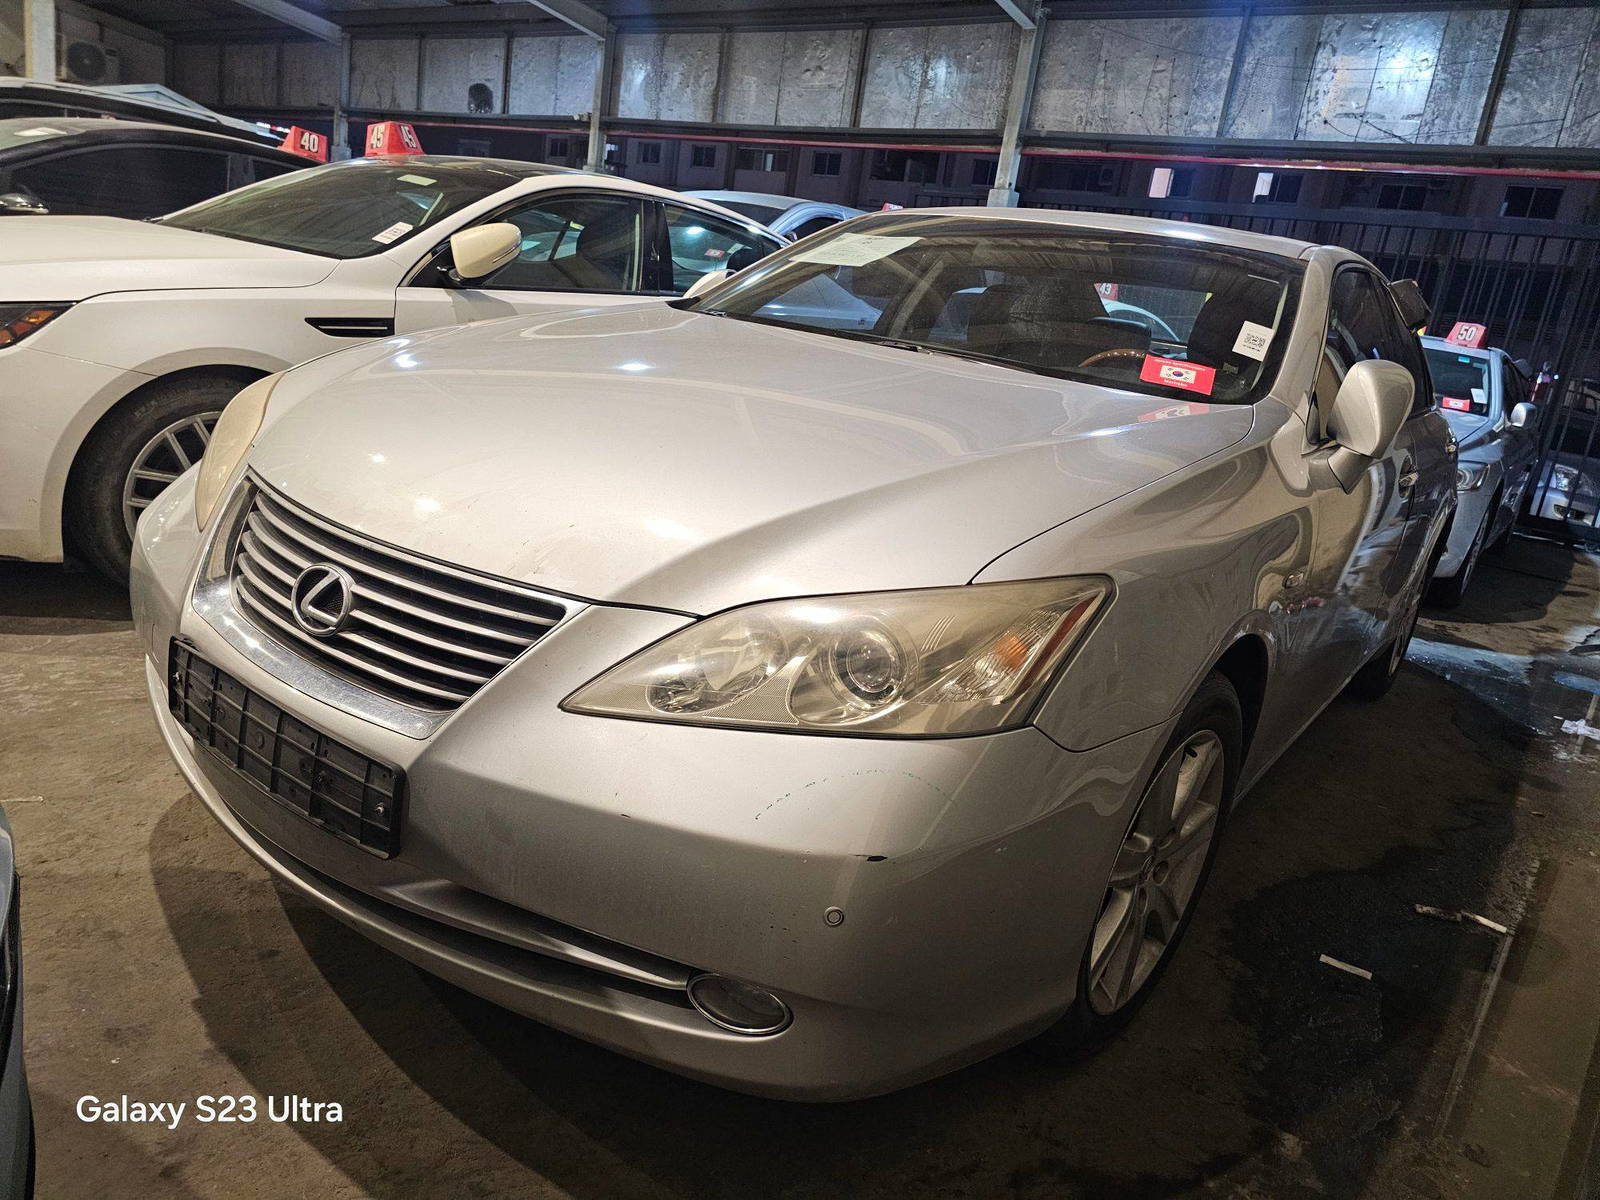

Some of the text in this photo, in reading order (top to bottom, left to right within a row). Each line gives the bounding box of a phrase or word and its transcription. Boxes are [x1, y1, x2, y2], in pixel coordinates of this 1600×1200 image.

[300, 132, 319, 153] 40
[370, 125, 385, 149] 45
[1458, 325, 1477, 341] 50
